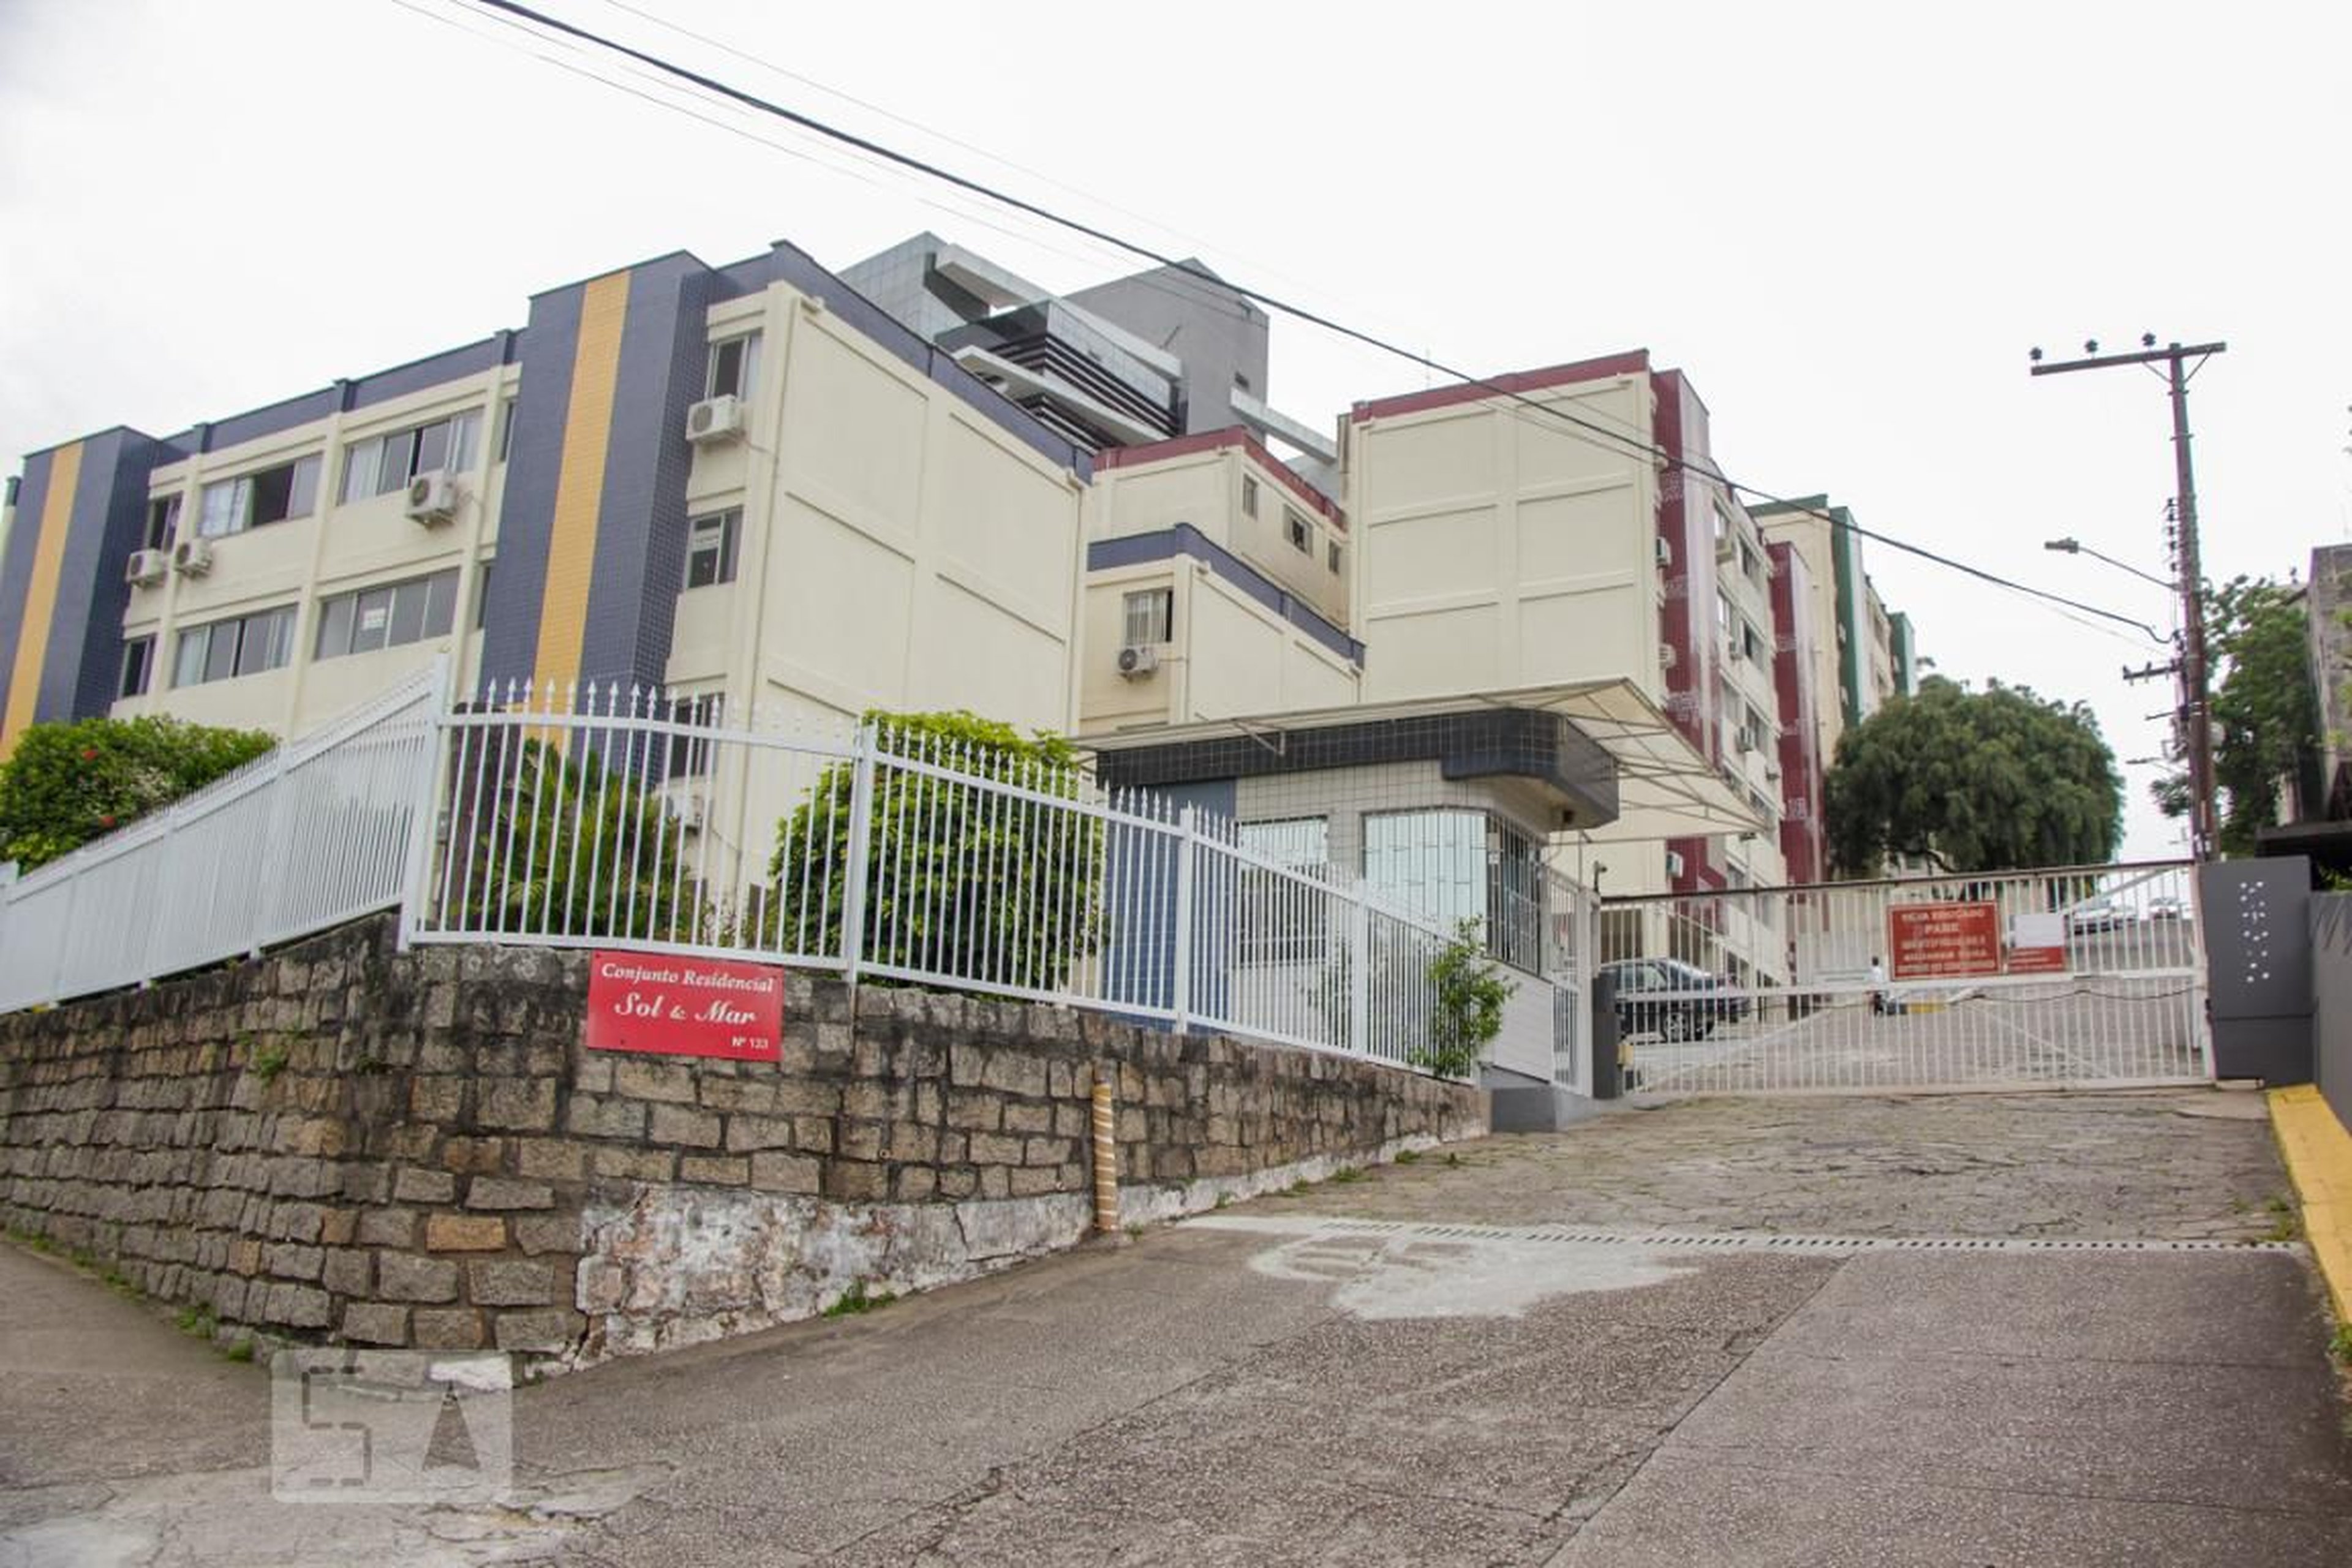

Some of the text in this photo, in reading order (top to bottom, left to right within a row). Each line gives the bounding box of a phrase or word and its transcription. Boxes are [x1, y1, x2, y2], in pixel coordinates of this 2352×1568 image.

[601, 962, 774, 993] Conjunto Residencial
[614, 992, 663, 1018] Sol
[695, 1000, 756, 1024] Mar
